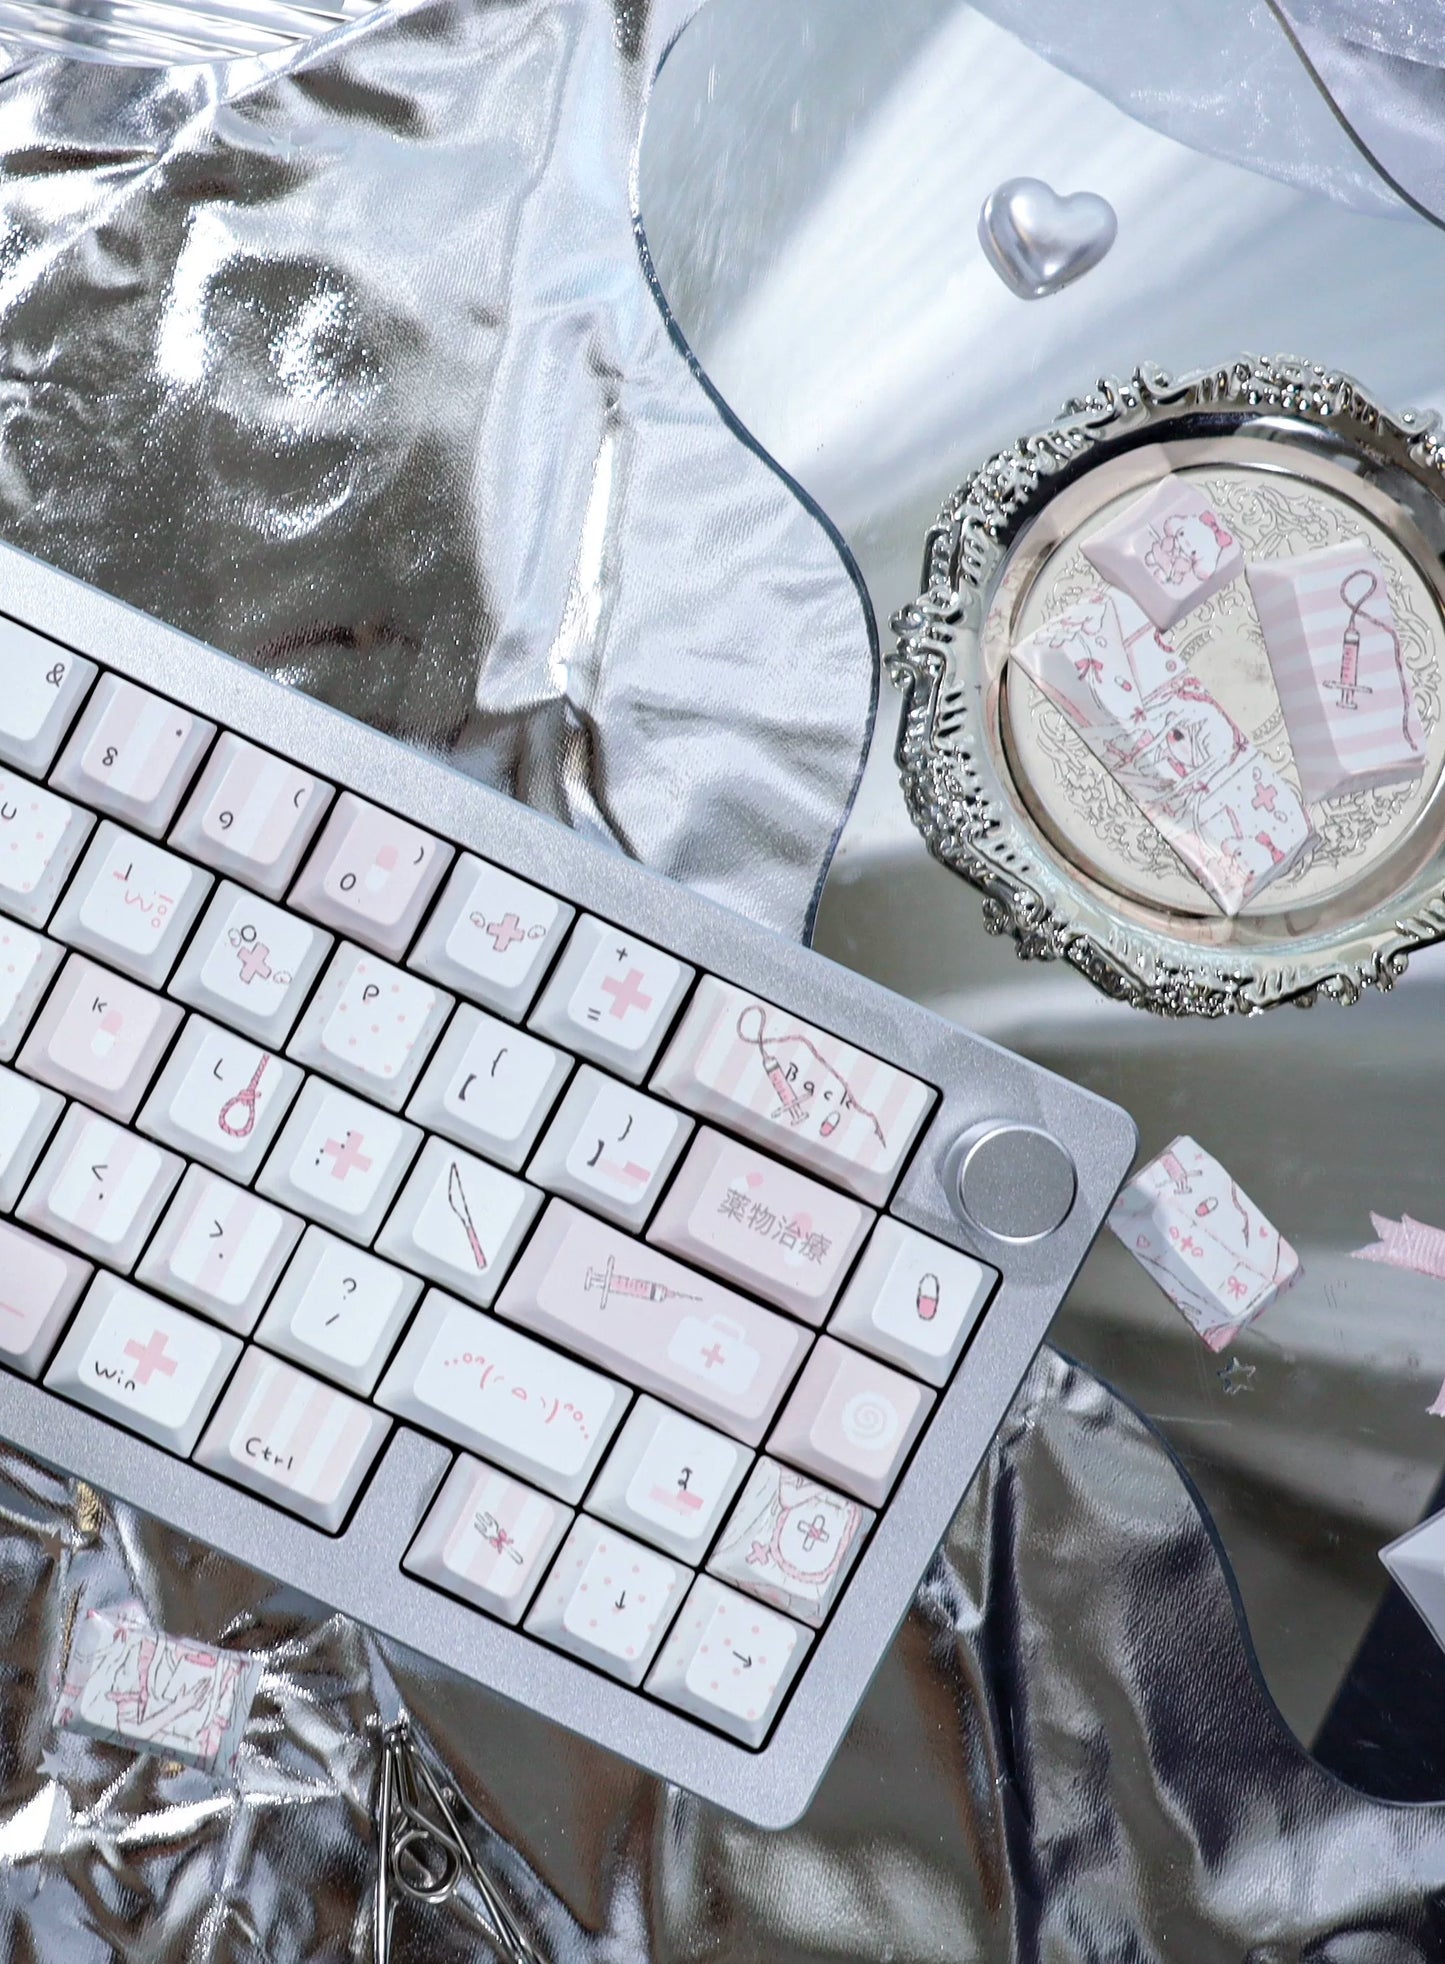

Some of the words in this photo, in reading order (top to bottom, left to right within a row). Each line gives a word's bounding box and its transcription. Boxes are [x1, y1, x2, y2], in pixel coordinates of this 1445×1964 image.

[101, 746, 119, 767] 8
[0, 801, 18, 821] U
[218, 810, 234, 830] 9
[362, 983, 380, 1002] P
[784, 1061, 854, 1111] Back
[716, 1187, 833, 1265] 薬物治療
[94, 1360, 136, 1391] Win
[244, 1436, 294, 1471] Ctrl
